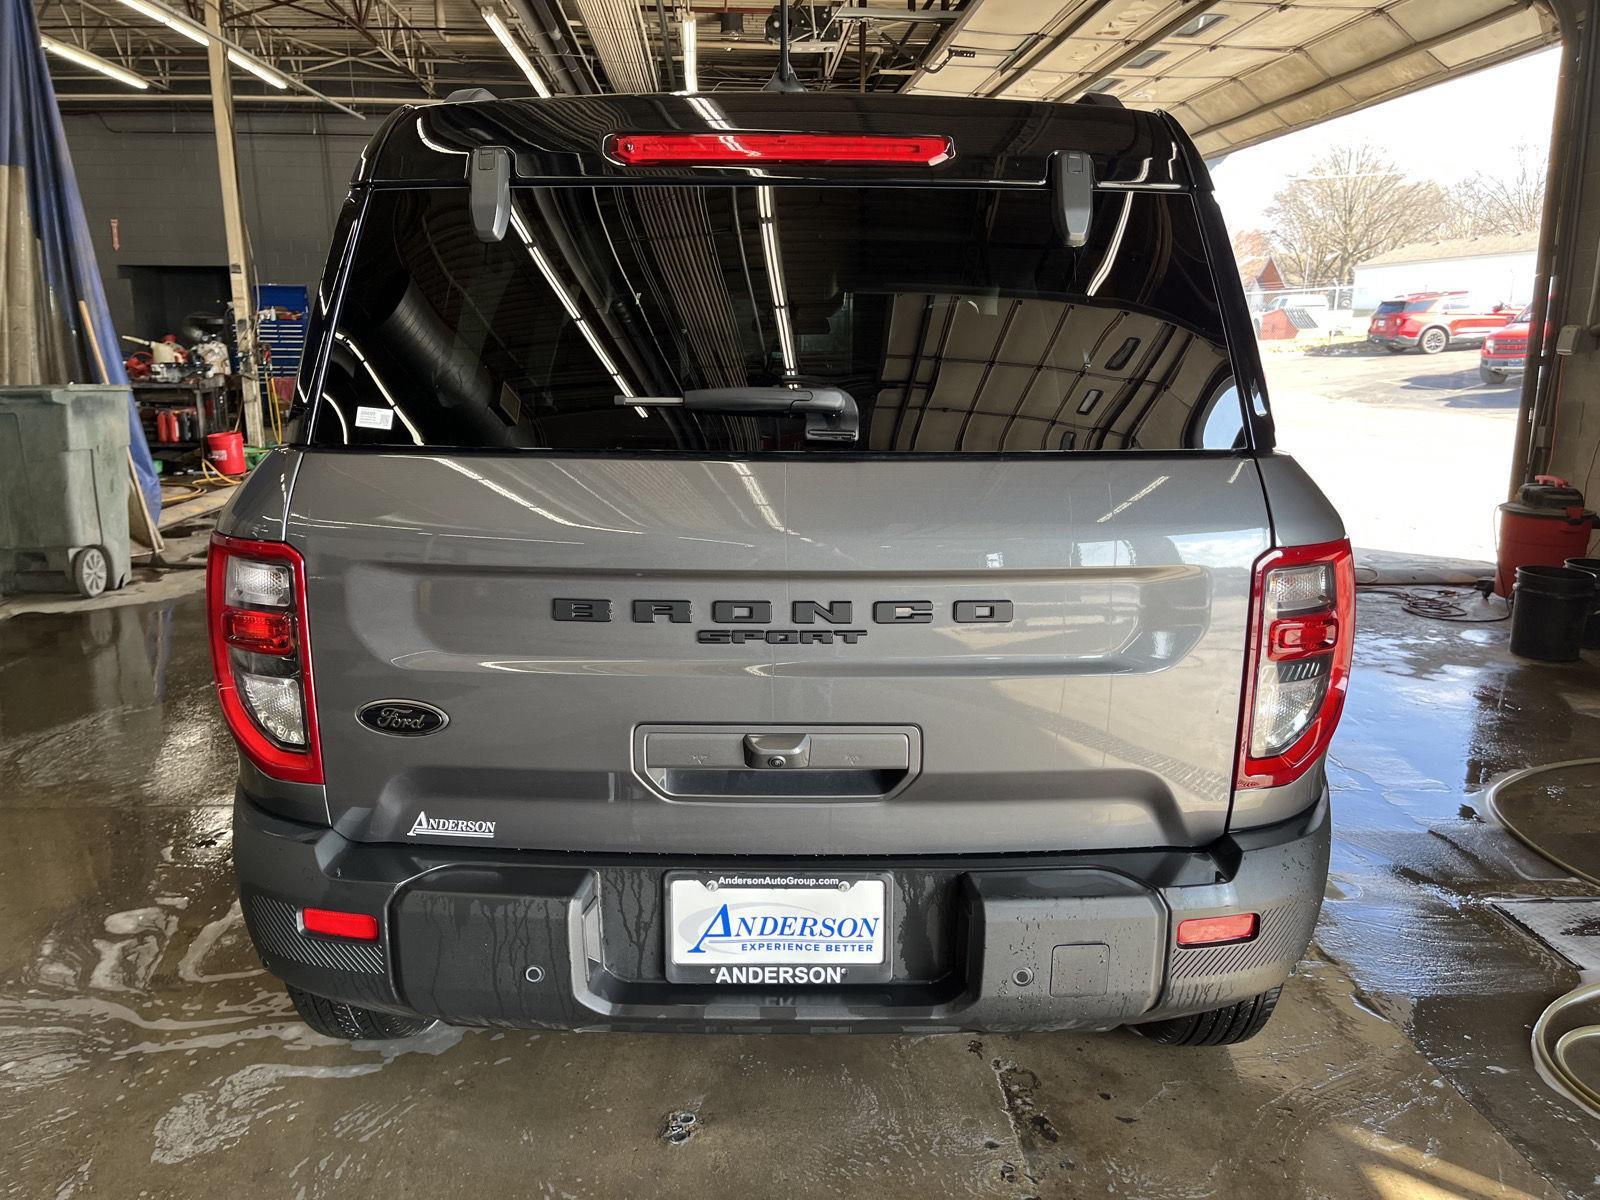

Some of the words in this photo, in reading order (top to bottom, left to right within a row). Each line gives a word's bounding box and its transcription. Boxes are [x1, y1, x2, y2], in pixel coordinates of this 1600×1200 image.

[552, 598, 1014, 624] BRONCO
[697, 629, 868, 644] SPORT
[376, 707, 425, 729] Ford
[406, 811, 496, 836] ANDERSON
[718, 876, 839, 886] AndersonAutoGroup.com
[687, 903, 880, 953] ANDERSON
[741, 943, 820, 952] EXPERIENCE
[825, 944, 873, 952] BETTER
[715, 967, 841, 984] ANDERSON
